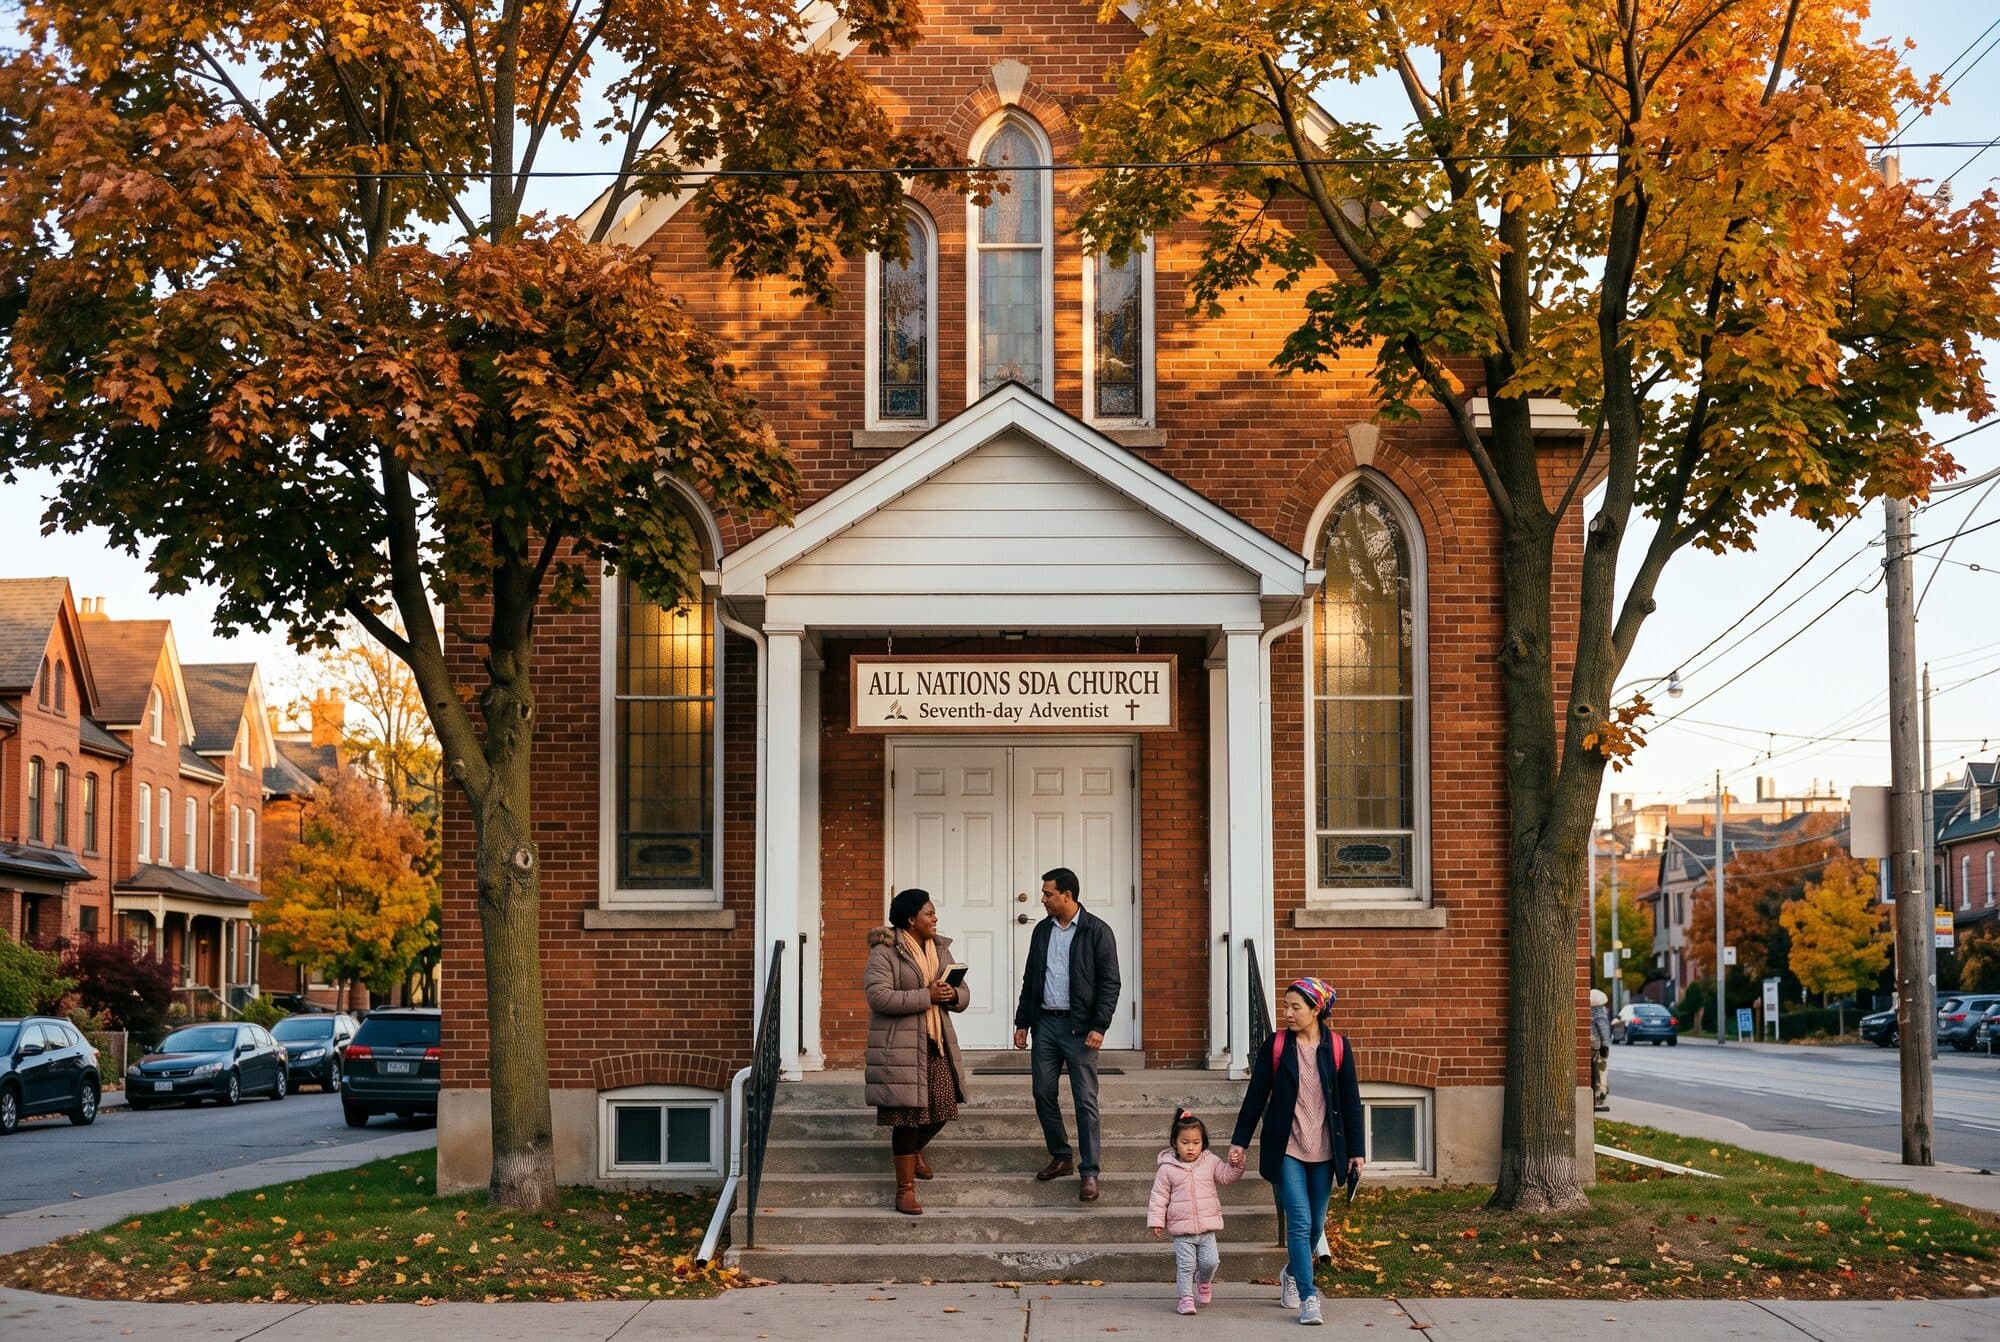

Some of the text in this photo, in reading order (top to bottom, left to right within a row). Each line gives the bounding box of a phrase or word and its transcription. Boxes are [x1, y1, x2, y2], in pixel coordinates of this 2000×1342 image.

[868, 670, 1160, 696] ALL NATIONS SDA CHURCH
[919, 701, 1109, 724] Seventh-day Adventist
